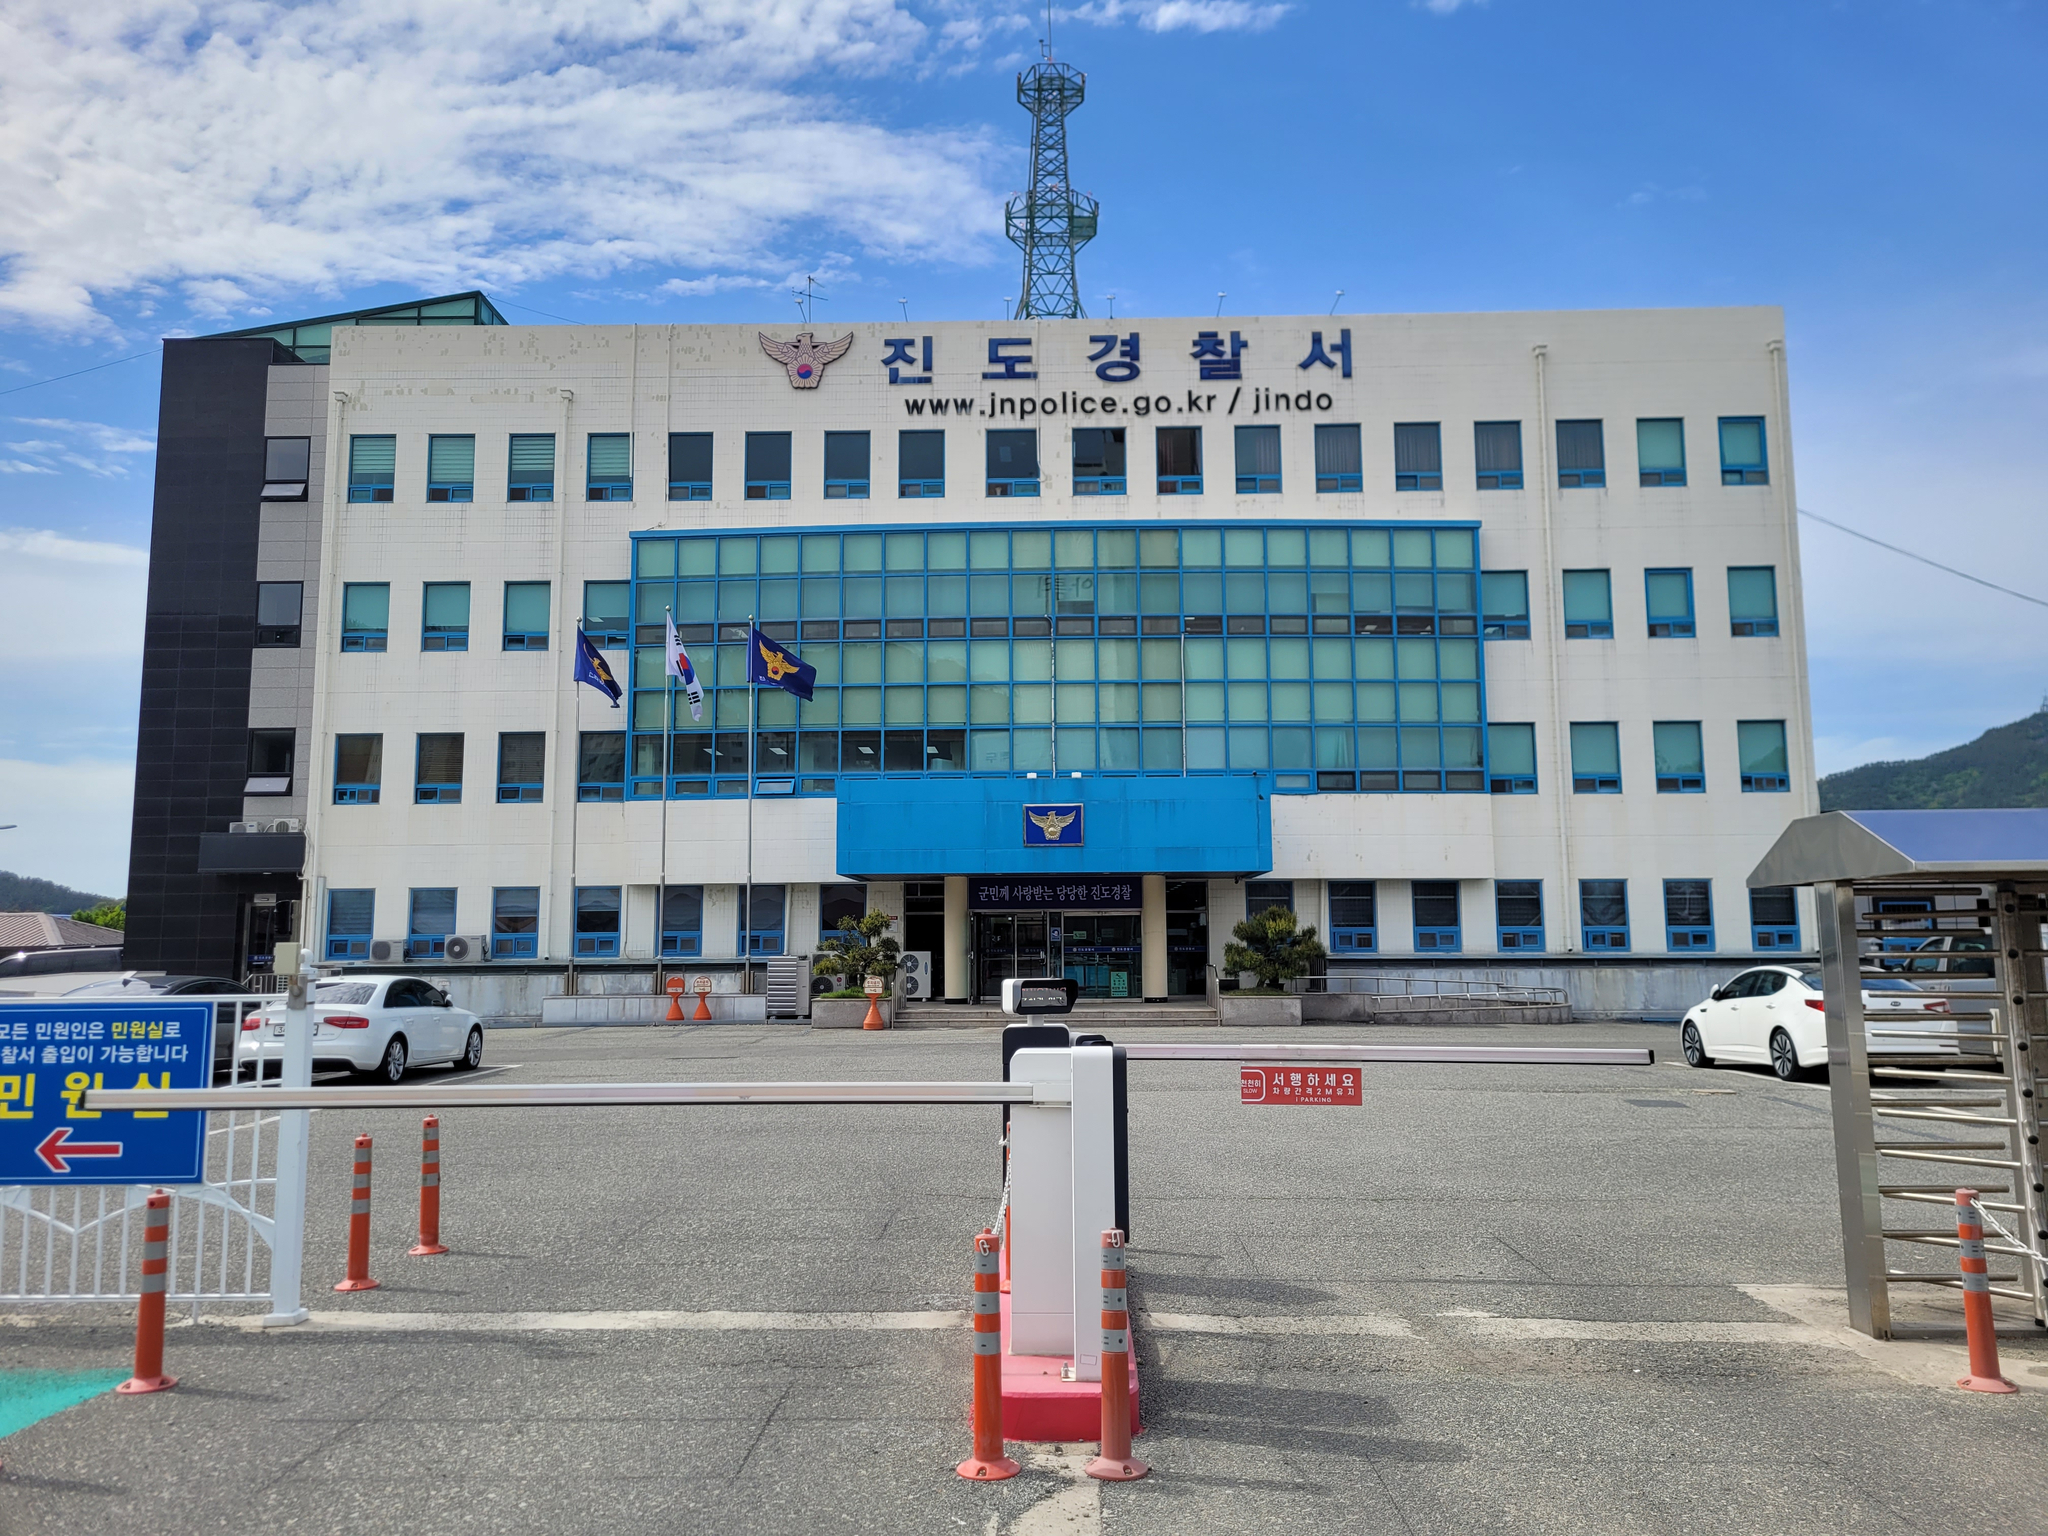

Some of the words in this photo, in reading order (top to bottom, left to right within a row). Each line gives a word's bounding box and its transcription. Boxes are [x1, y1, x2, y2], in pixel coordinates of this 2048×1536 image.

[881, 328, 1354, 385] 진도경찰서
[978, 885, 1010, 901] 군민께
[1012, 885, 1054, 901] 사랑받는
[1056, 885, 1088, 901] 당당한
[1090, 884, 1132, 900] 진도경찰
[35, 1022, 104, 1041] 민원인은
[111, 1021, 181, 1040] 민원실로
[1, 1045, 36, 1065] 찰서
[41, 1045, 94, 1065] 출입이
[100, 1044, 189, 1064] 가능합니다
[1272, 1072, 1355, 1087] 서행하세요
